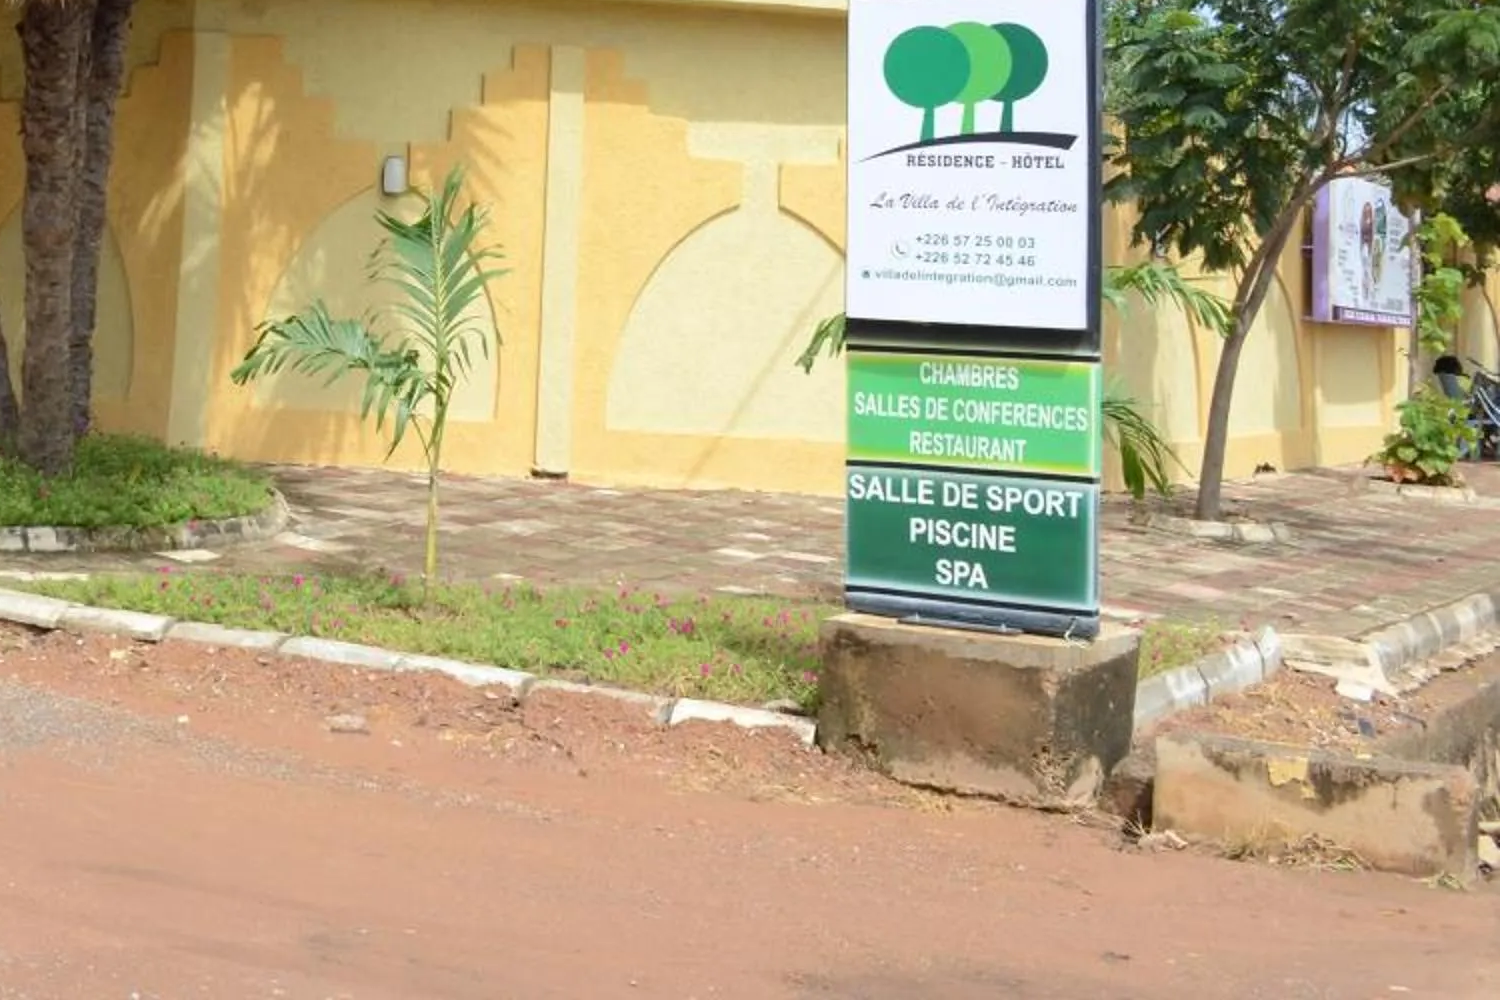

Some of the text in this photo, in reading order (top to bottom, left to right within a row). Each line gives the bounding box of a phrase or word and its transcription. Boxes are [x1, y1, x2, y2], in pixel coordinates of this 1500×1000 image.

[907, 151, 995, 169] RÉSIDENCE
[1012, 152, 1065, 169] HÔTEL
[869, 191, 895, 209] La
[900, 192, 940, 210] Villa
[945, 193, 965, 211] de
[915, 234, 949, 246] +226
[953, 234, 970, 247] 57
[975, 235, 993, 247] 25
[915, 252, 1036, 267] +226 52 72 45 46
[919, 361, 1020, 390] CHAMBRES
[854, 391, 1089, 432] SALLES DE CONFERENCES
[909, 430, 1027, 462] RESTAURANT
[849, 473, 1084, 518] SALLE DE SPORT
[909, 517, 1017, 553] PISCINE
[935, 558, 989, 590] SPA
